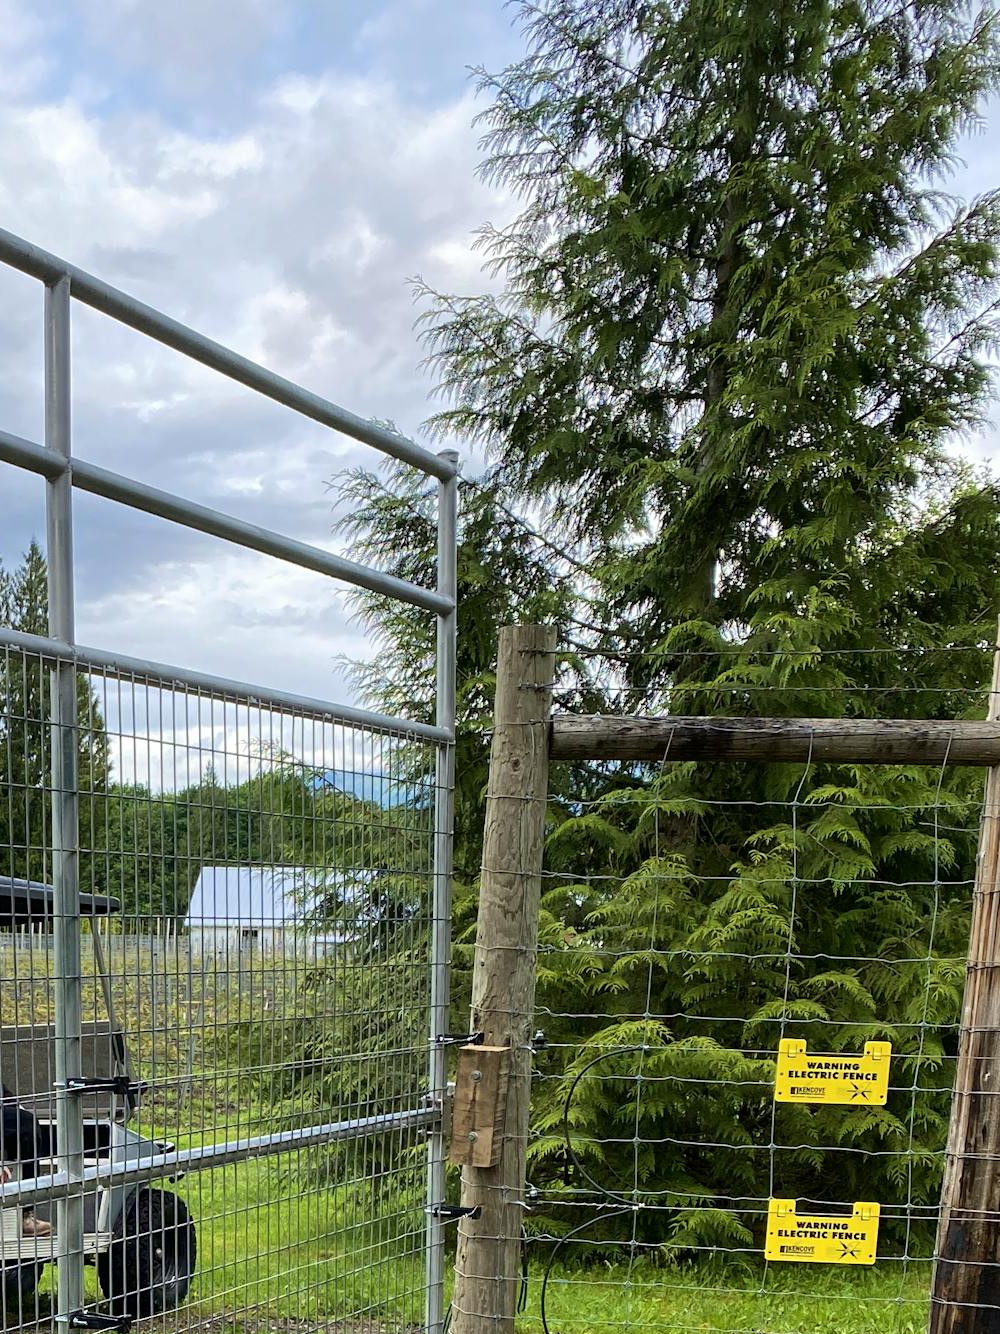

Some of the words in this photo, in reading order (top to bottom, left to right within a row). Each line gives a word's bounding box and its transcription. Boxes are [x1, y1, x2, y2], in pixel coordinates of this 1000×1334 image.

[807, 1062, 860, 1071] WARNING
[788, 1071, 839, 1079] ELECTRIC
[843, 1072, 877, 1081] FENCE
[796, 1221, 848, 1230] WARNING
[778, 1230, 828, 1239] ELECTRIC
[832, 1232, 866, 1240] FENCE
